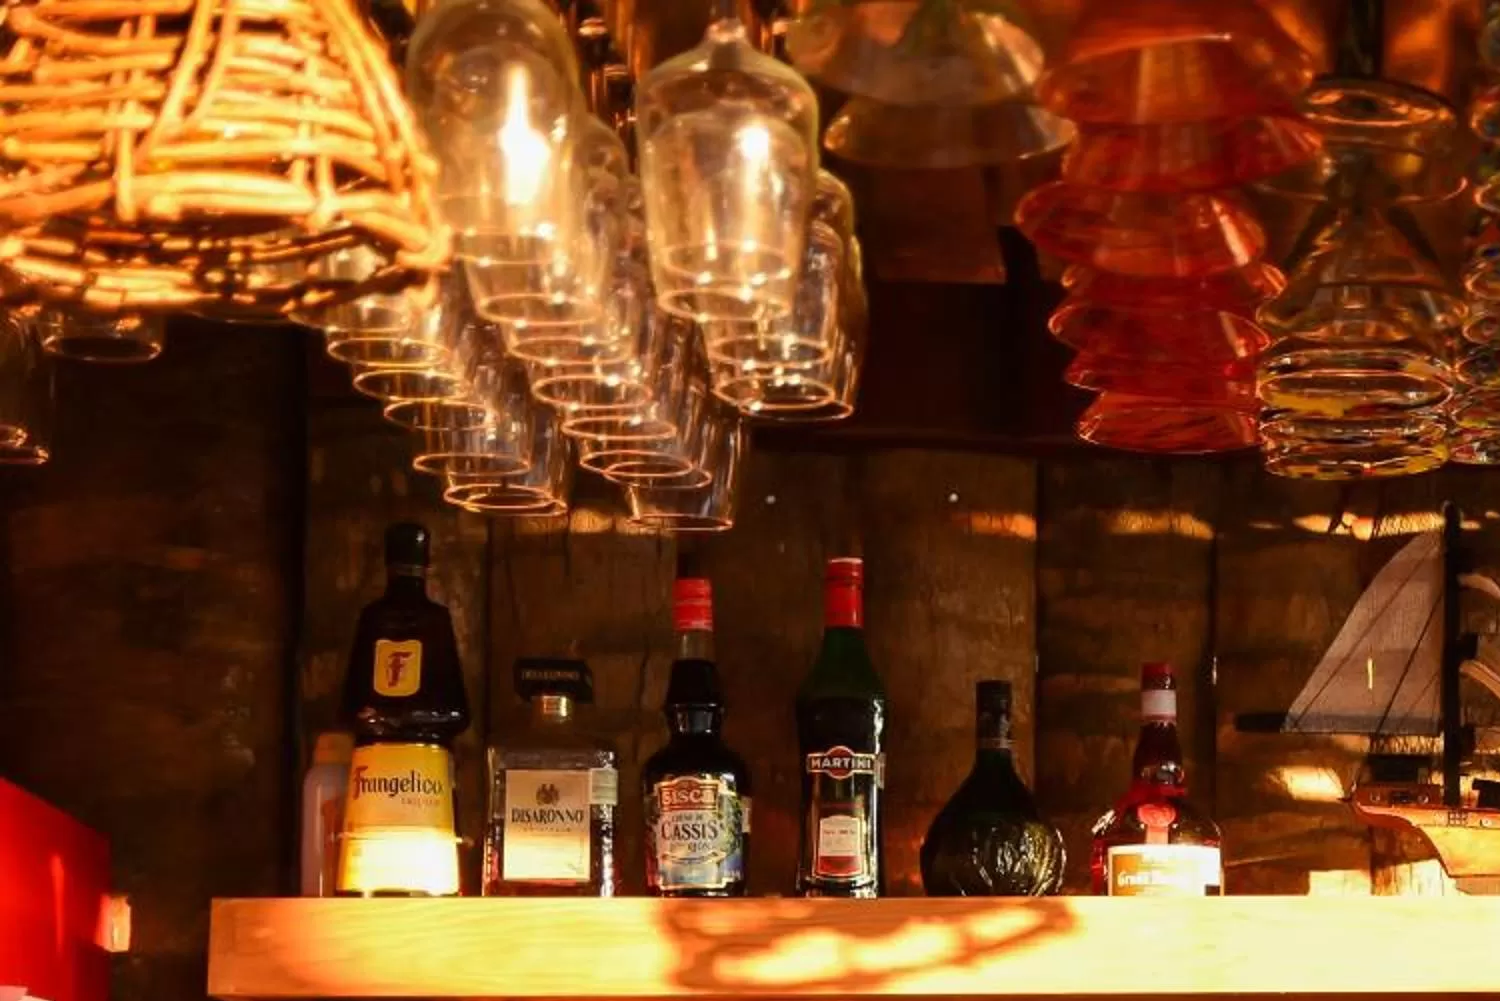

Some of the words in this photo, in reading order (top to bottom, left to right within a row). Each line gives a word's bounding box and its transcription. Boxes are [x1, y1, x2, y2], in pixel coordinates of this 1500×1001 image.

[811, 757, 871, 769] MARTINI
[352, 765, 443, 800] Frangelico
[511, 807, 585, 824] DISARONNO
[661, 819, 719, 840] CASSIS
